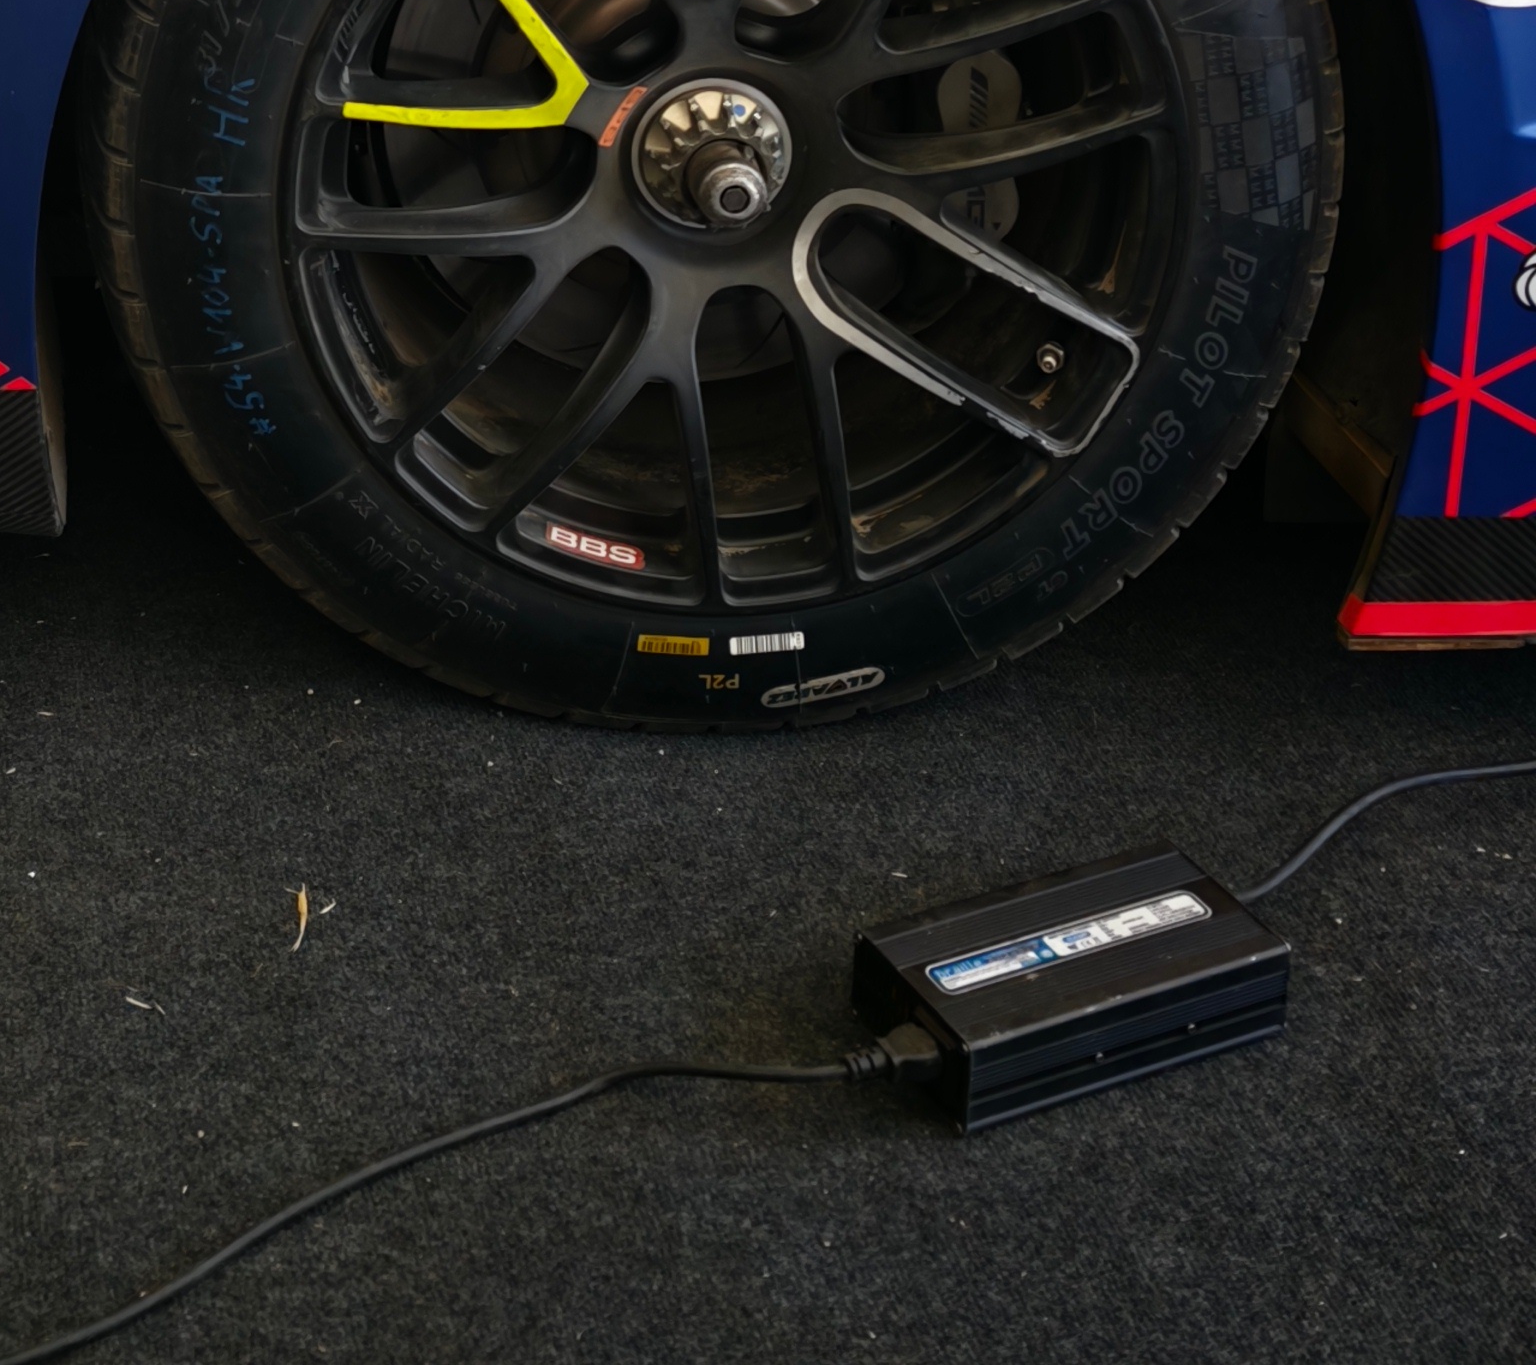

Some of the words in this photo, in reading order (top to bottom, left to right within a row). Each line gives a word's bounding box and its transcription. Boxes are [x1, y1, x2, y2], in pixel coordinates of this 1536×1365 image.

[1177, 244, 1258, 410] PILOT
[1058, 407, 1186, 561] SPORT
[550, 526, 640, 567] BBS
[698, 673, 742, 690] P2L
